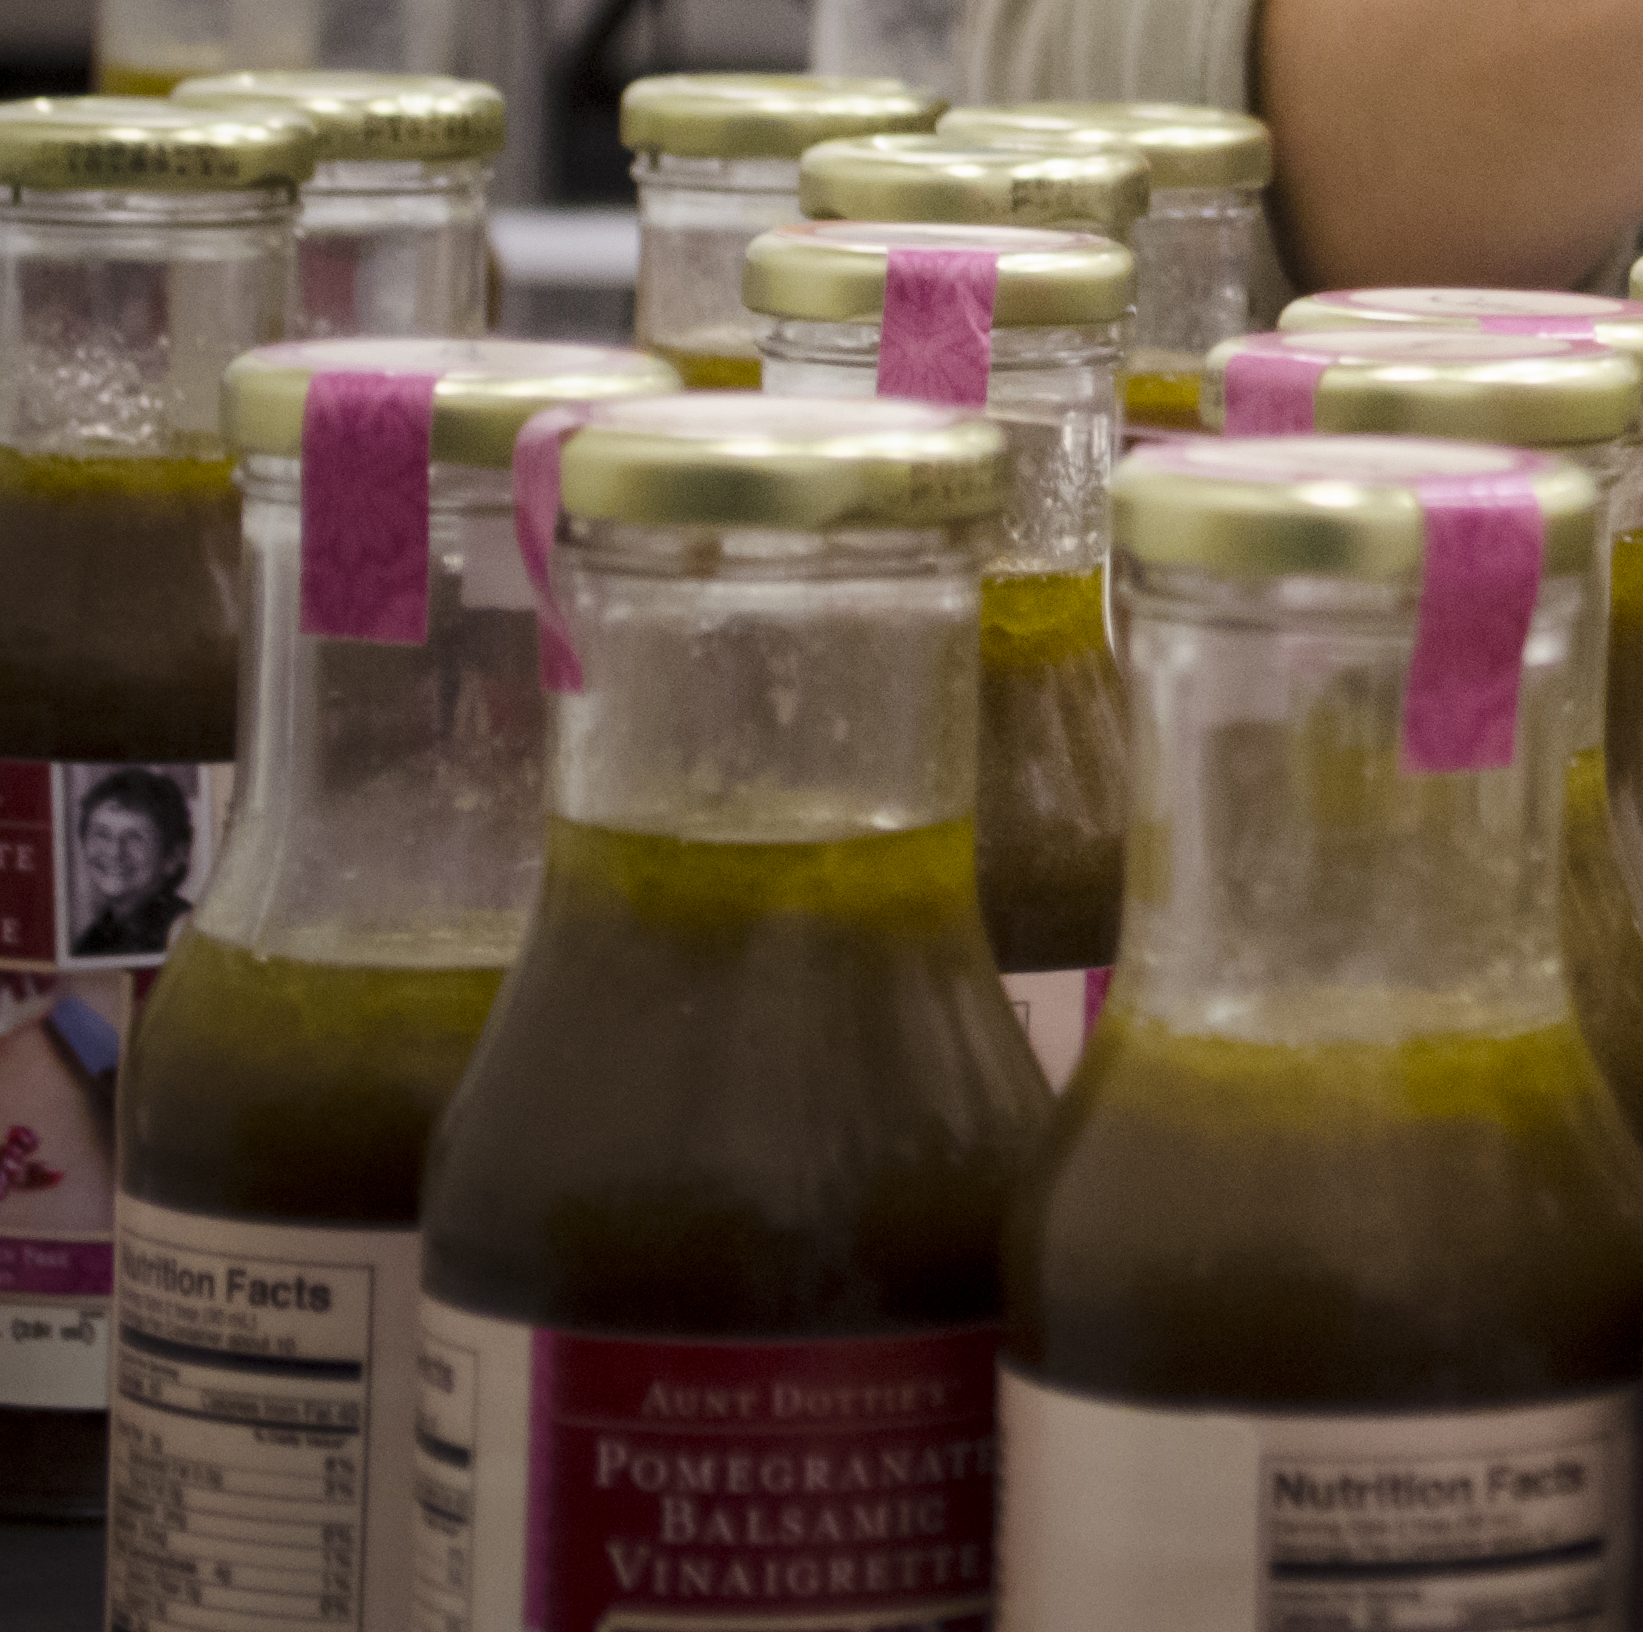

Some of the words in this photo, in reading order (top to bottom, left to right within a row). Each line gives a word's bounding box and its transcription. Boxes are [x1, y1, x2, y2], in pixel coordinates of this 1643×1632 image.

[226, 1267, 333, 1315] Facts
[641, 1378, 757, 1419] AUNT
[1272, 1469, 1474, 1511] Nutrition
[659, 1494, 948, 1546] BALSAMIC
[604, 1541, 982, 1596] VINAIGRETTE
